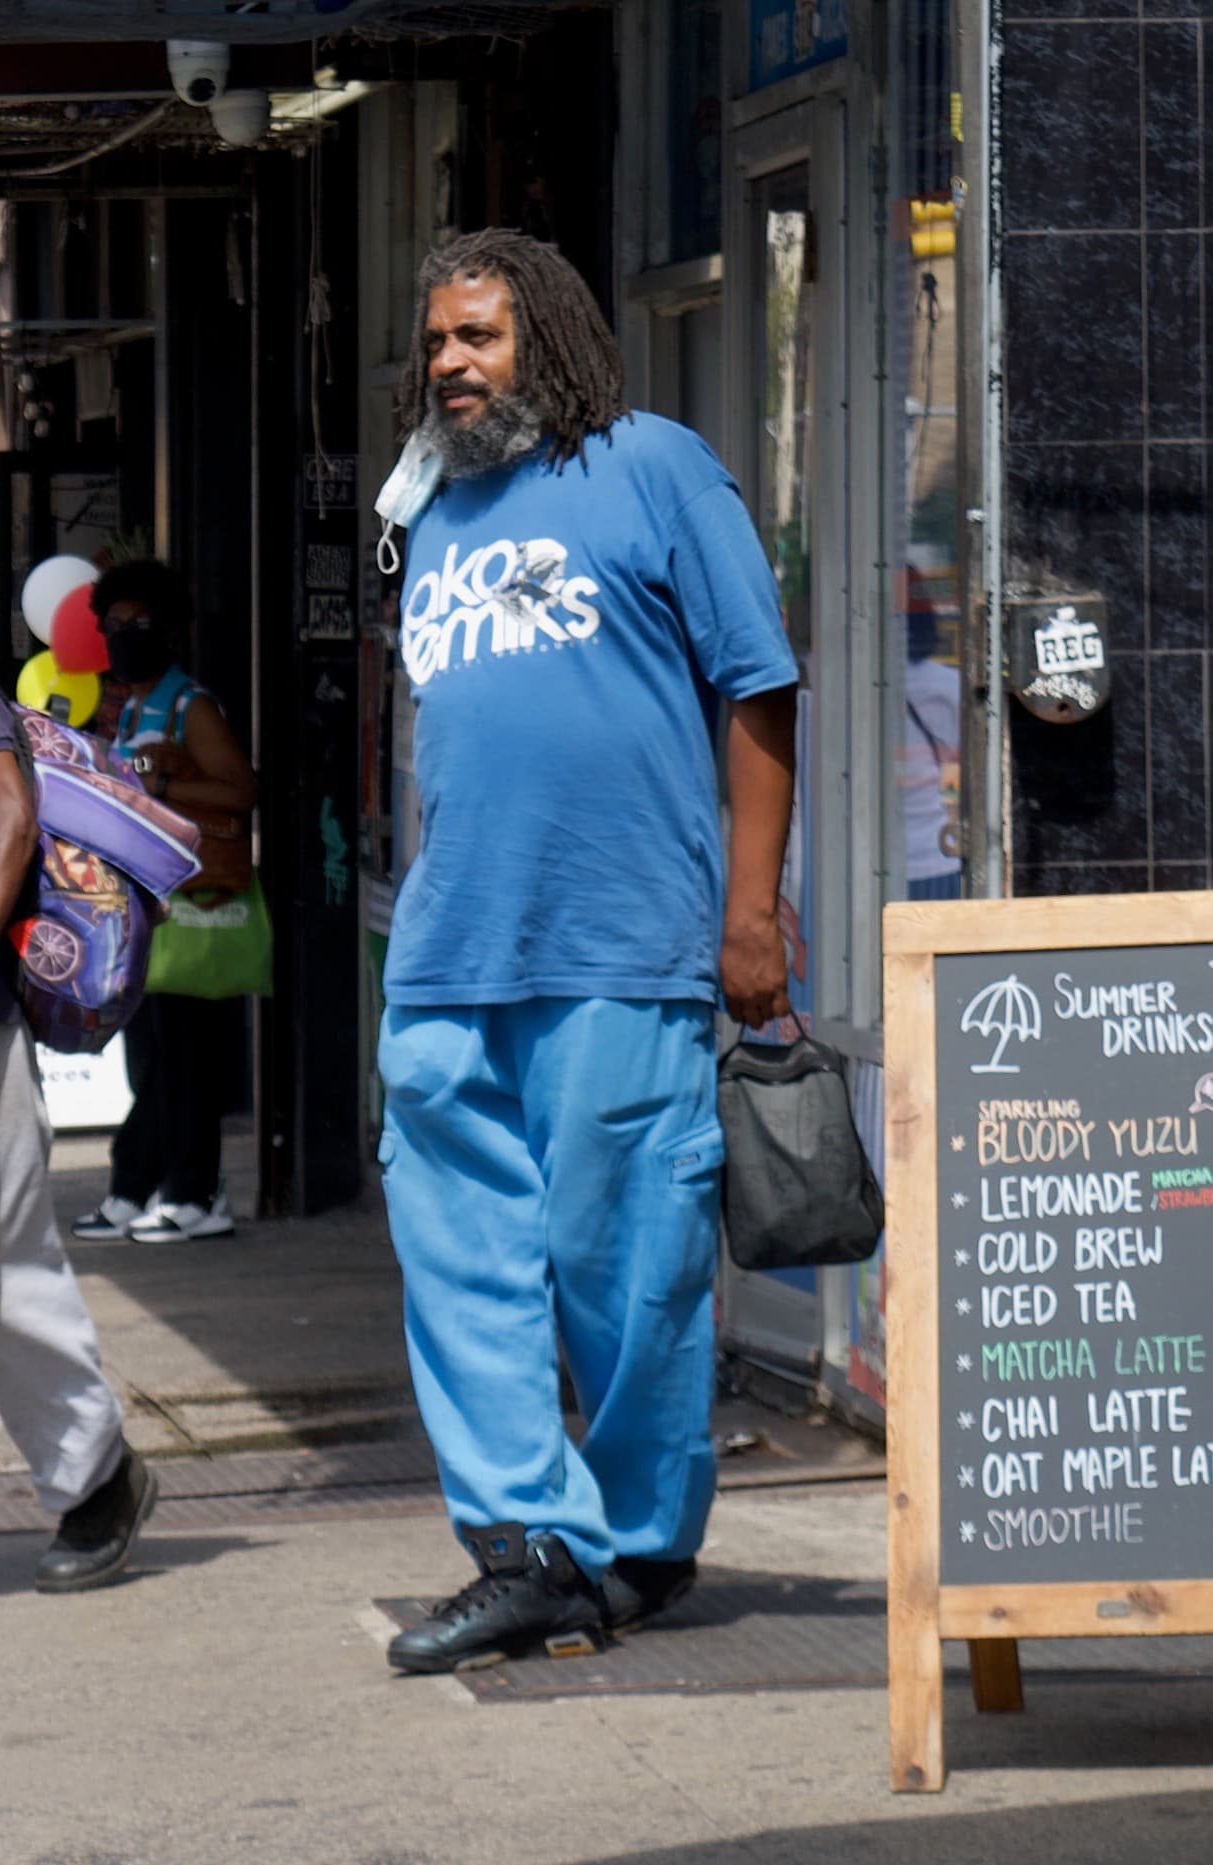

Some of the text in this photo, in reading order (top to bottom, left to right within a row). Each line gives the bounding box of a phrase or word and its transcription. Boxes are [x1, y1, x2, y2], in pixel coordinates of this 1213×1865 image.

[1054, 973, 1178, 1019] SUMMER
[1103, 1012, 1213, 1058] DRINKS
[978, 1099, 1081, 1122] SPARKLING
[978, 1116, 1199, 1167] BLOODY YUZU
[981, 1171, 1143, 1222] LEMONADE
[978, 1226, 1163, 1275] COLD BREW
[981, 1280, 1137, 1329] ICED TEA
[982, 1334, 1207, 1383] MATCHA LATTE
[982, 1386, 1192, 1443] CHAI LATTE
[982, 1452, 1043, 1499] OAT
[1062, 1446, 1158, 1494] MAPLE
[983, 1502, 1144, 1551] SMOOTHIE
